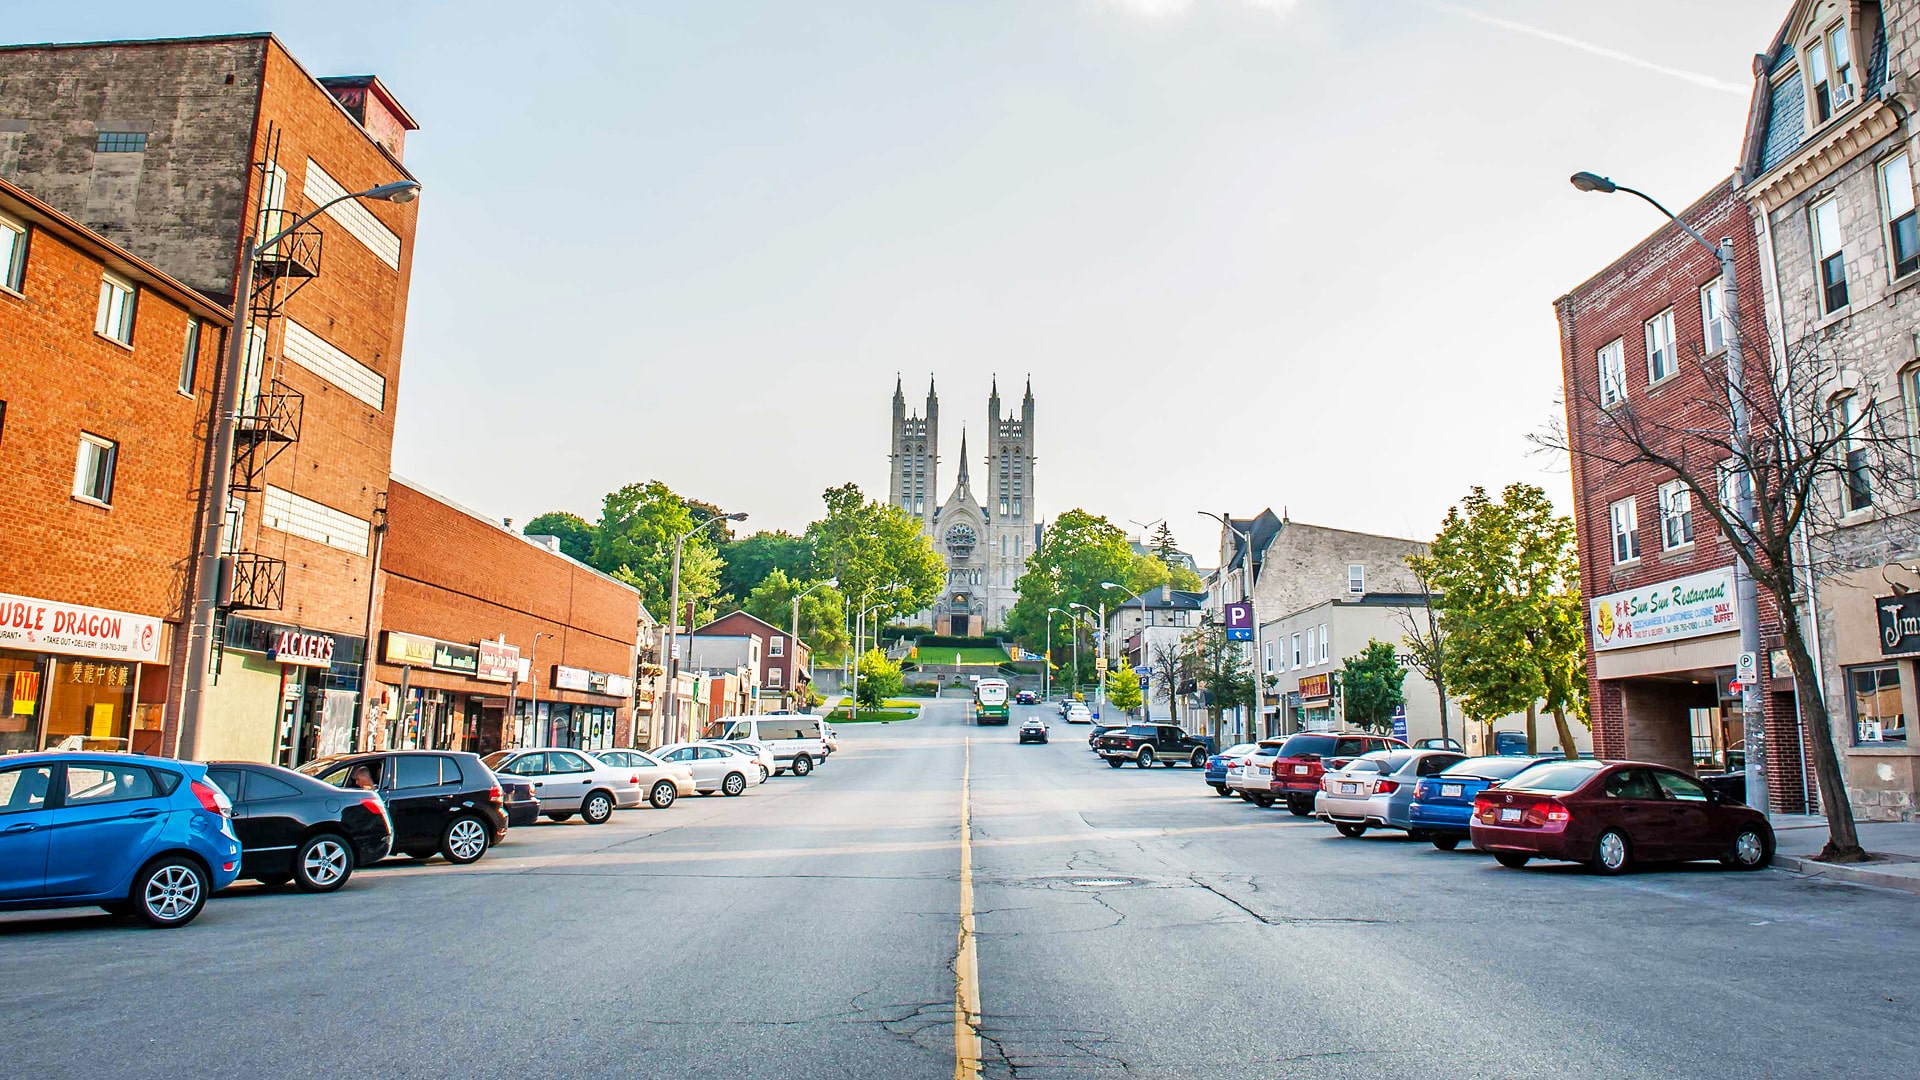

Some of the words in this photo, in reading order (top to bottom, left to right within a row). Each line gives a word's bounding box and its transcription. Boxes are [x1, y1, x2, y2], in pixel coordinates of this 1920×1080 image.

[1630, 596, 1648, 617] Sun
[1650, 592, 1669, 613] Sun
[1672, 581, 1725, 606] Restaurant
[1714, 602, 1730, 613] DAILY
[53, 610, 122, 640] DRAGON
[1231, 607, 1245, 625] P
[1713, 611, 1734, 624] BUFFET
[45, 635, 60, 645] TAKE
[60, 637, 72, 646] OUT
[74, 639, 97, 649] DELIVERY
[278, 631, 335, 660] ACKER'S
[13, 671, 39, 701] ATM
[1396, 705, 1401, 716] P
